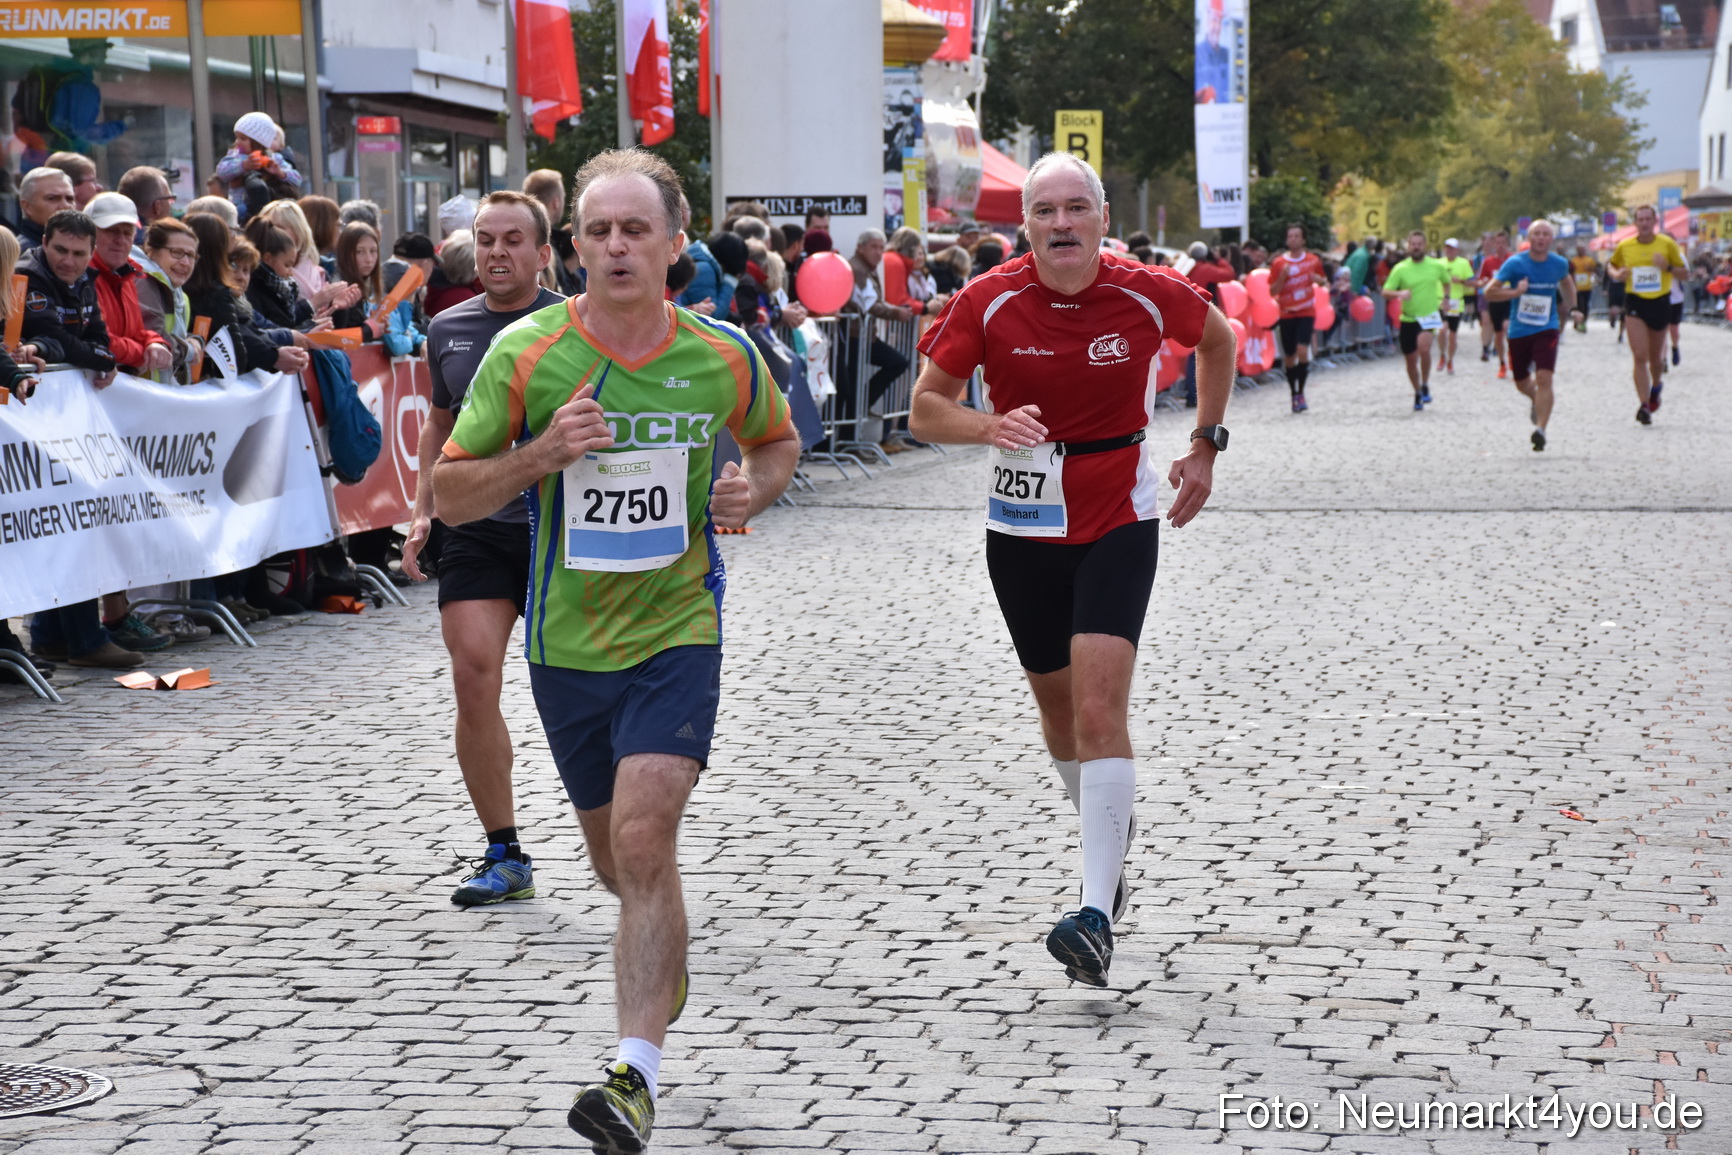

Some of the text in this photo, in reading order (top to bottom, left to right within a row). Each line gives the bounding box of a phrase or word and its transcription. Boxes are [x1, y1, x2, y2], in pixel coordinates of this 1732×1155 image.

[1061, 114, 1097, 126] Block
[1068, 133, 1089, 162] B
[1366, 210, 1379, 230] C
[603, 411, 715, 449] OCK
[610, 461, 651, 474] BOCK
[994, 465, 1047, 499] 2257
[0, 505, 65, 545] ENIGER
[62, 493, 141, 532] VERBRAUCH.
[583, 485, 668, 525] 2750
[1002, 506, 1039, 519] Bernhard
